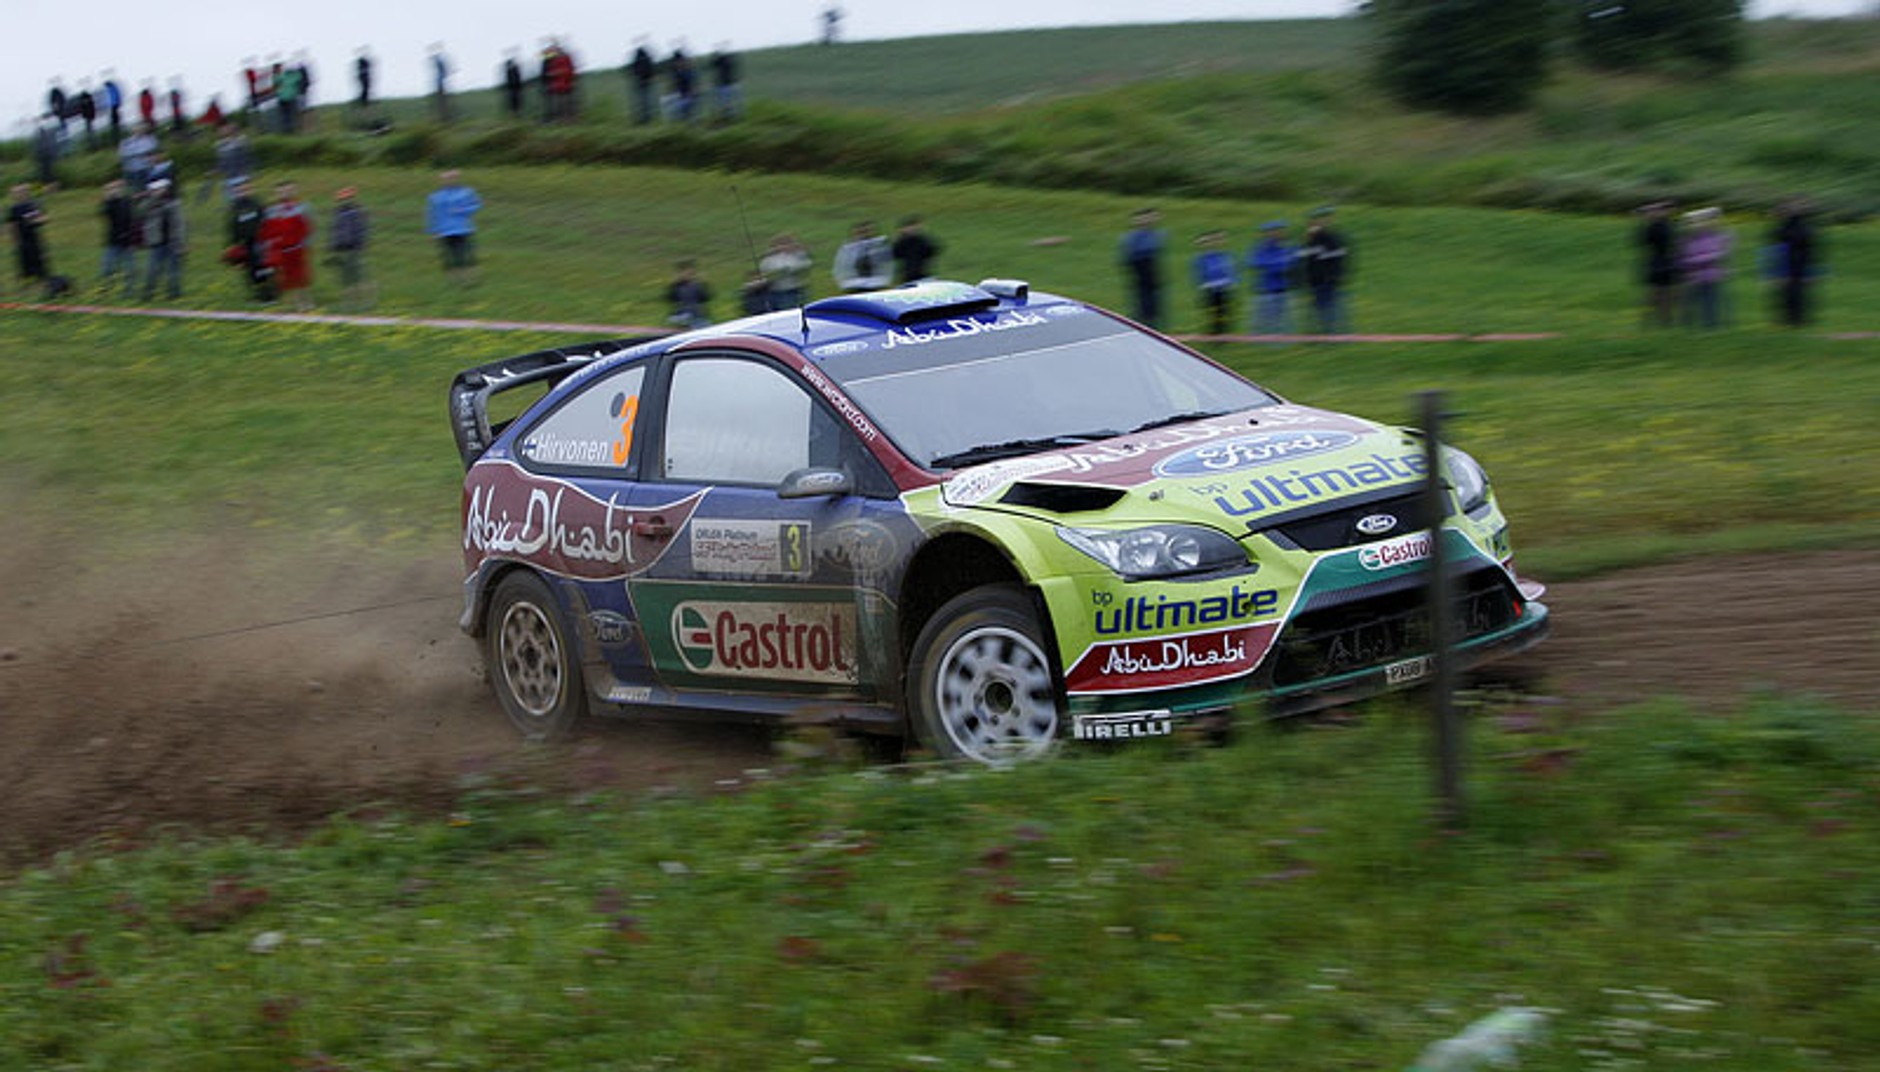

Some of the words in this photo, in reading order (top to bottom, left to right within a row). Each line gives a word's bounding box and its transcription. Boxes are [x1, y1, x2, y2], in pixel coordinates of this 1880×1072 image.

[535, 433, 608, 464] Hirvonen
[613, 395, 640, 465] 3
[1196, 434, 1331, 469] Ford
[1212, 452, 1429, 517] ultimate
[786, 524, 801, 572] 3
[1092, 590, 1113, 606] bp
[1095, 586, 1278, 635] ultimate
[715, 609, 848, 672] Castrol
